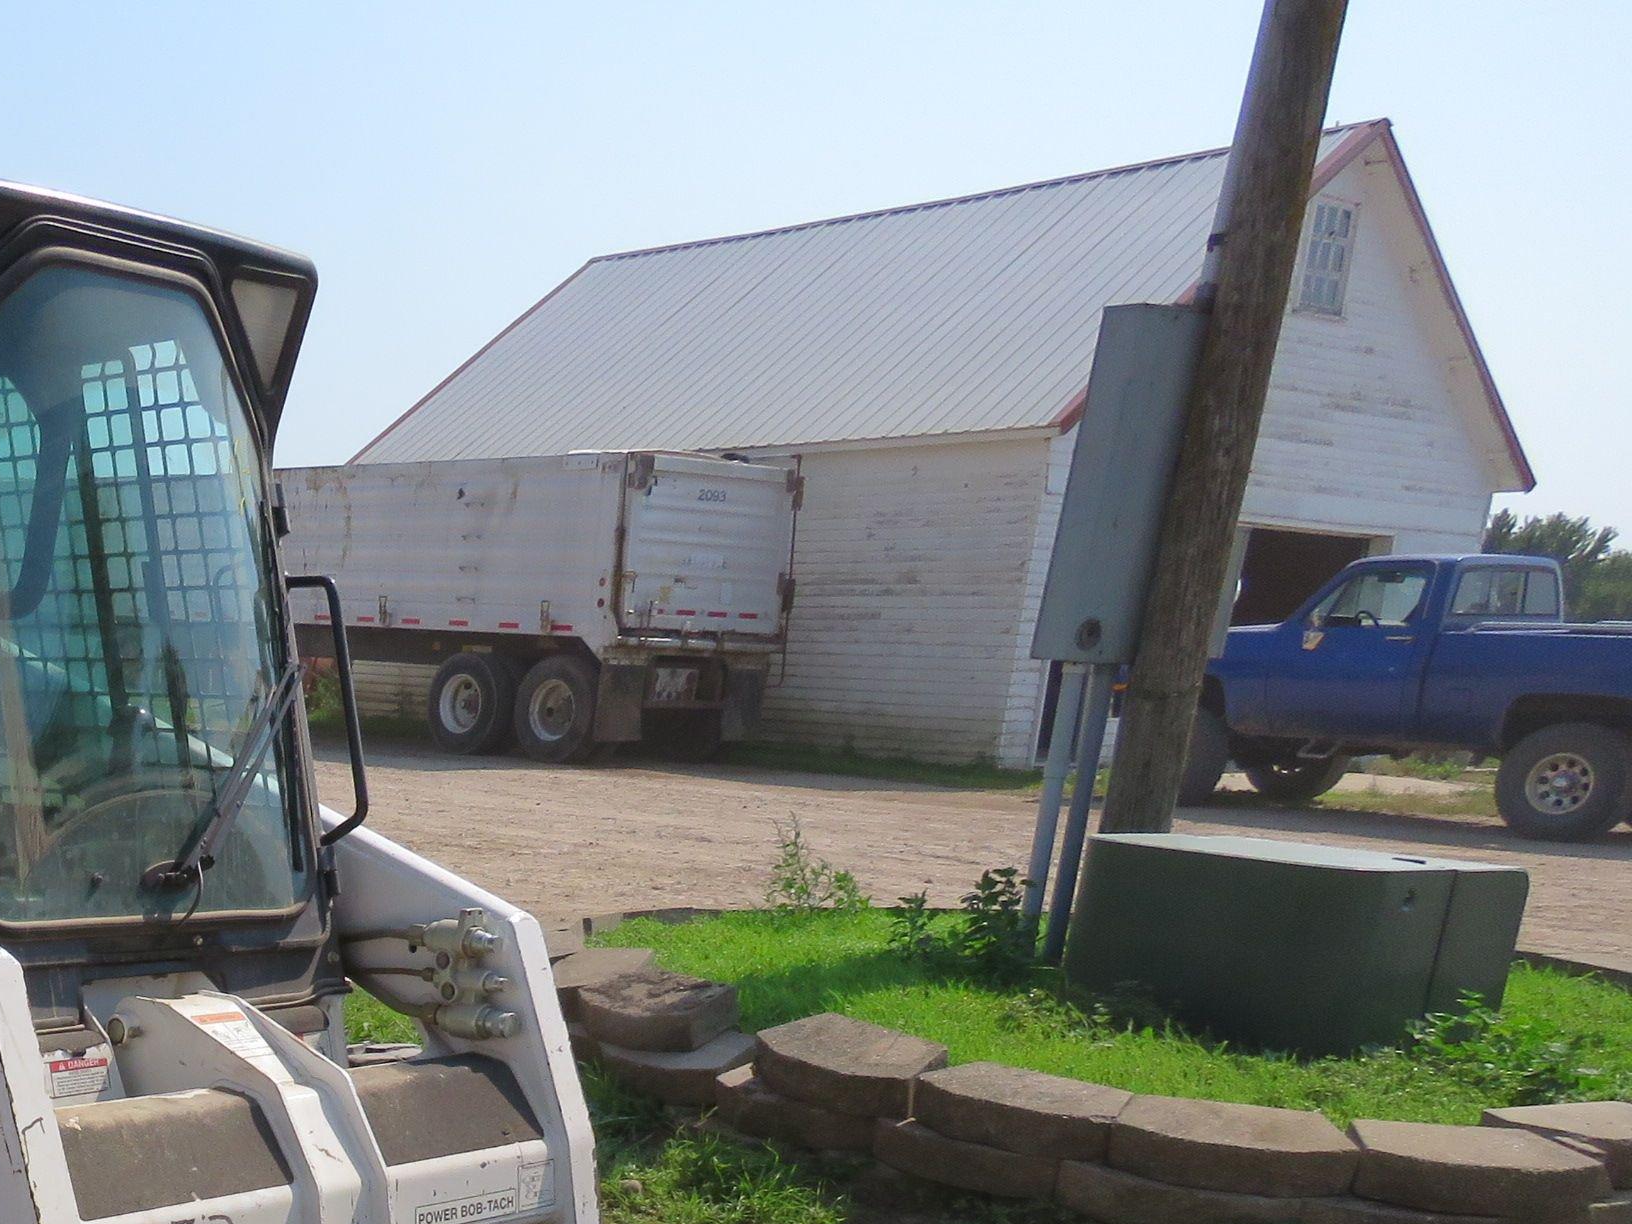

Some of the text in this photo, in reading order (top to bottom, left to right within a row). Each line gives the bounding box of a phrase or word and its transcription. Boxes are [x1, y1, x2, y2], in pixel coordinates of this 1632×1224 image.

[697, 488, 728, 503] 2093
[67, 1058, 100, 1069] DANGER
[460, 1195, 515, 1218] BOB-TACH
